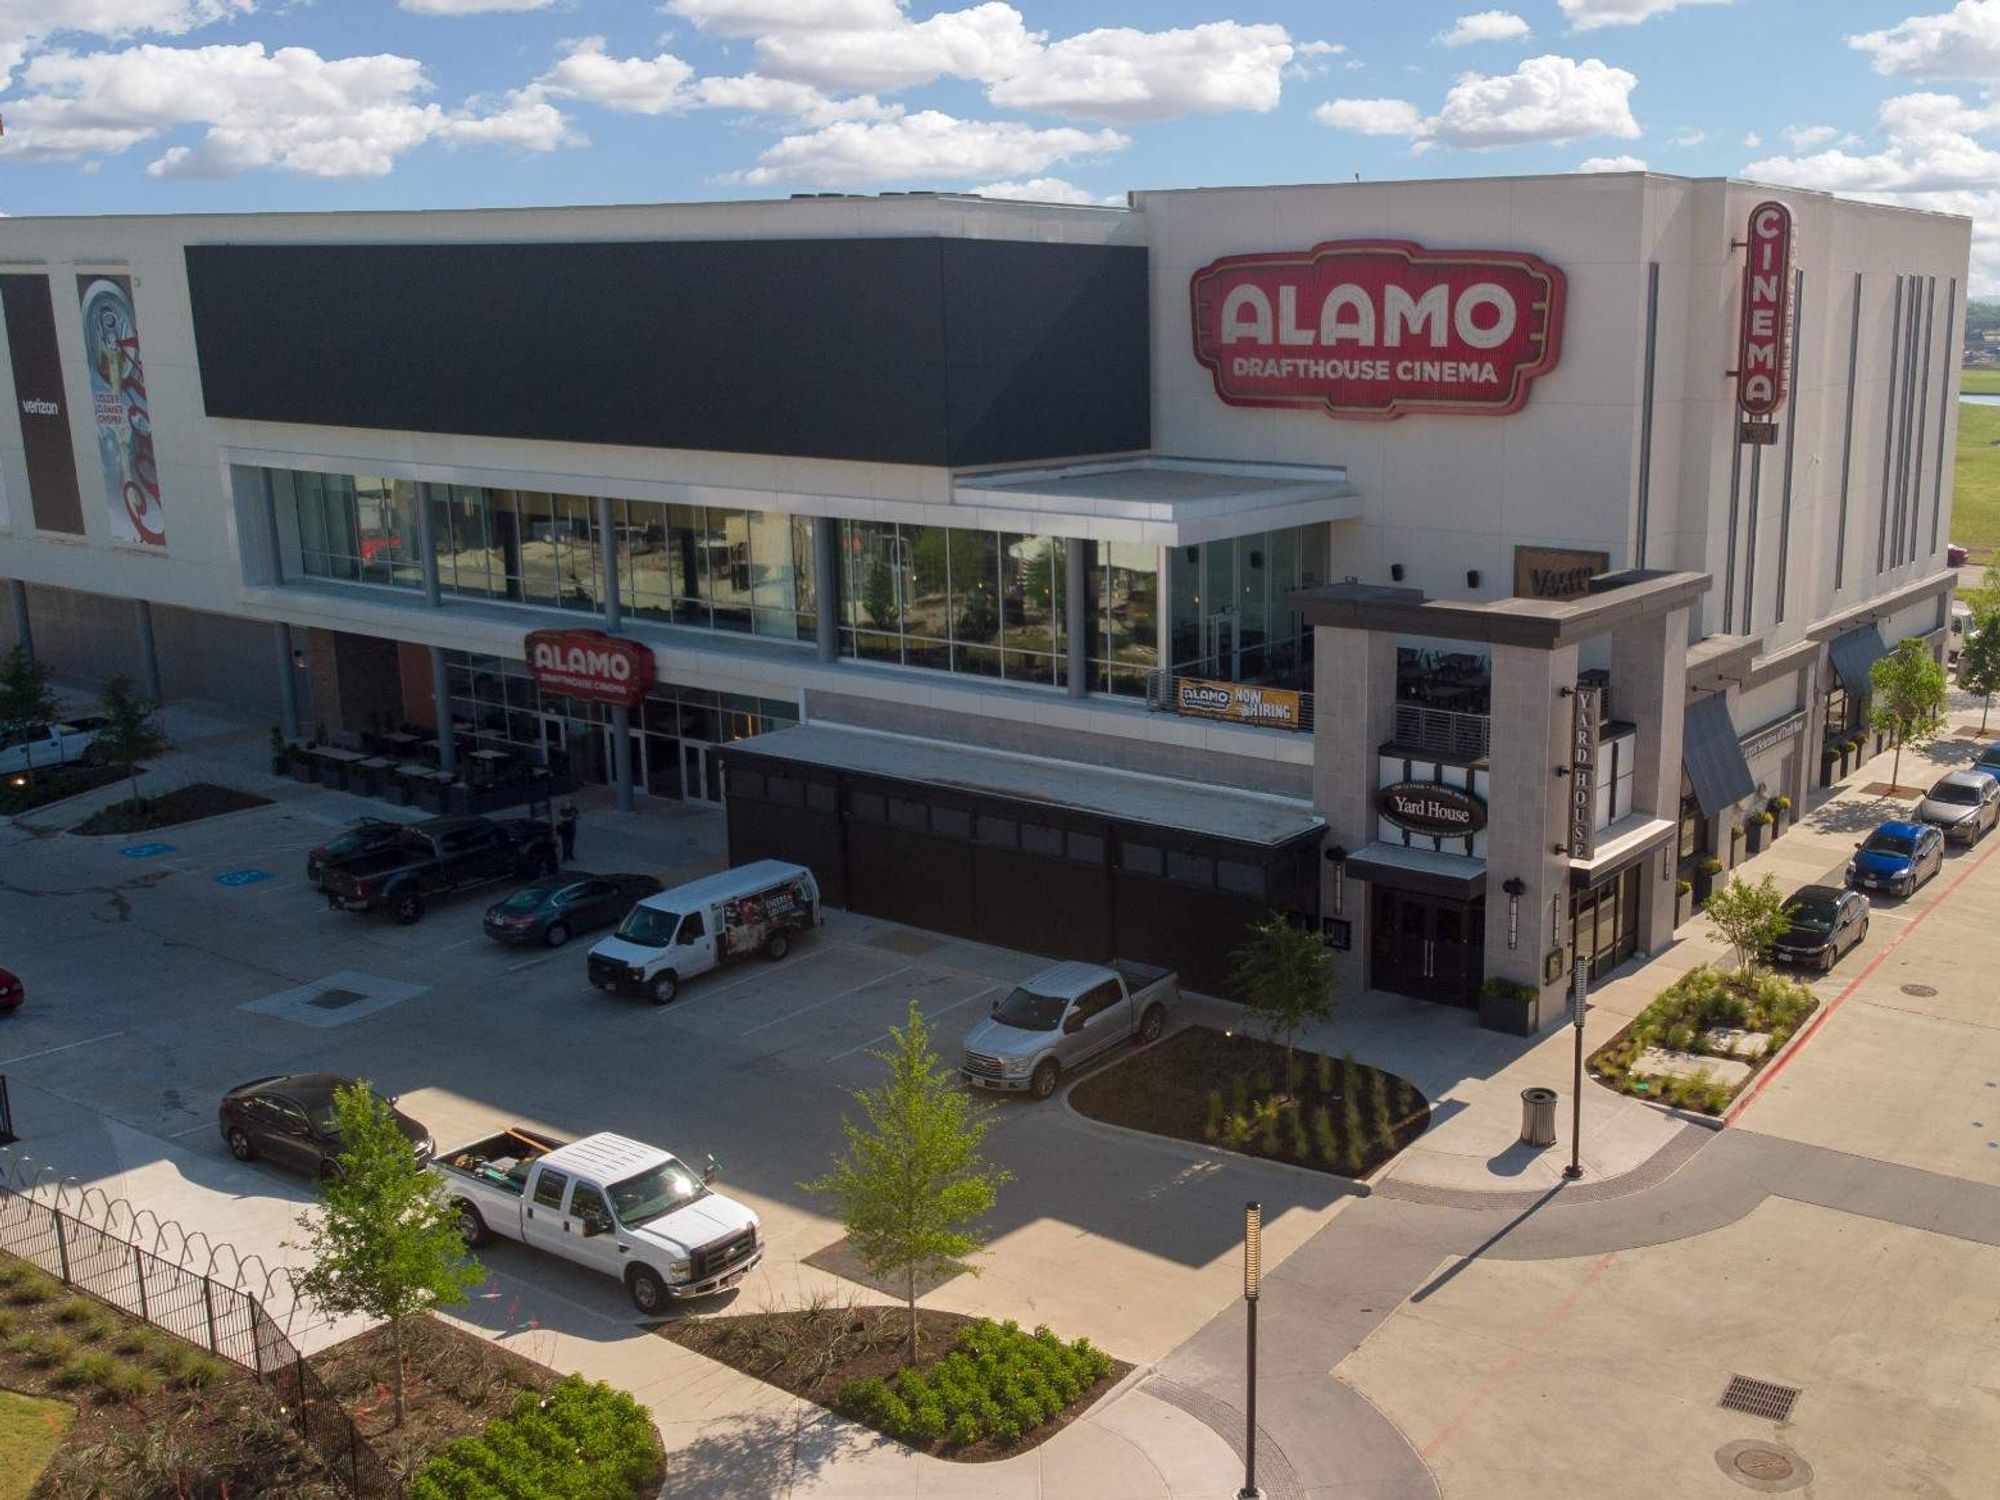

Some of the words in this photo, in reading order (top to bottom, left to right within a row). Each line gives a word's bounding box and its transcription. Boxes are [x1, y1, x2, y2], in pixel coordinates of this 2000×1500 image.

[1220, 282, 1517, 349] ALAMO
[1746, 210, 1779, 401] CINEMA
[1232, 357, 1390, 381] DRAFTHOUSE
[1396, 360, 1499, 384] CINEMA
[22, 398, 58, 416] verizon
[534, 642, 630, 681] ALAMO
[1183, 688, 1228, 703] ALAMO
[1234, 688, 1262, 704] NOW
[1250, 702, 1291, 719] HIRING
[1577, 694, 1590, 762] YARD
[1394, 795, 1425, 816] Yard
[1427, 801, 1470, 823] House
[1575, 773, 1588, 858] HOUSE
